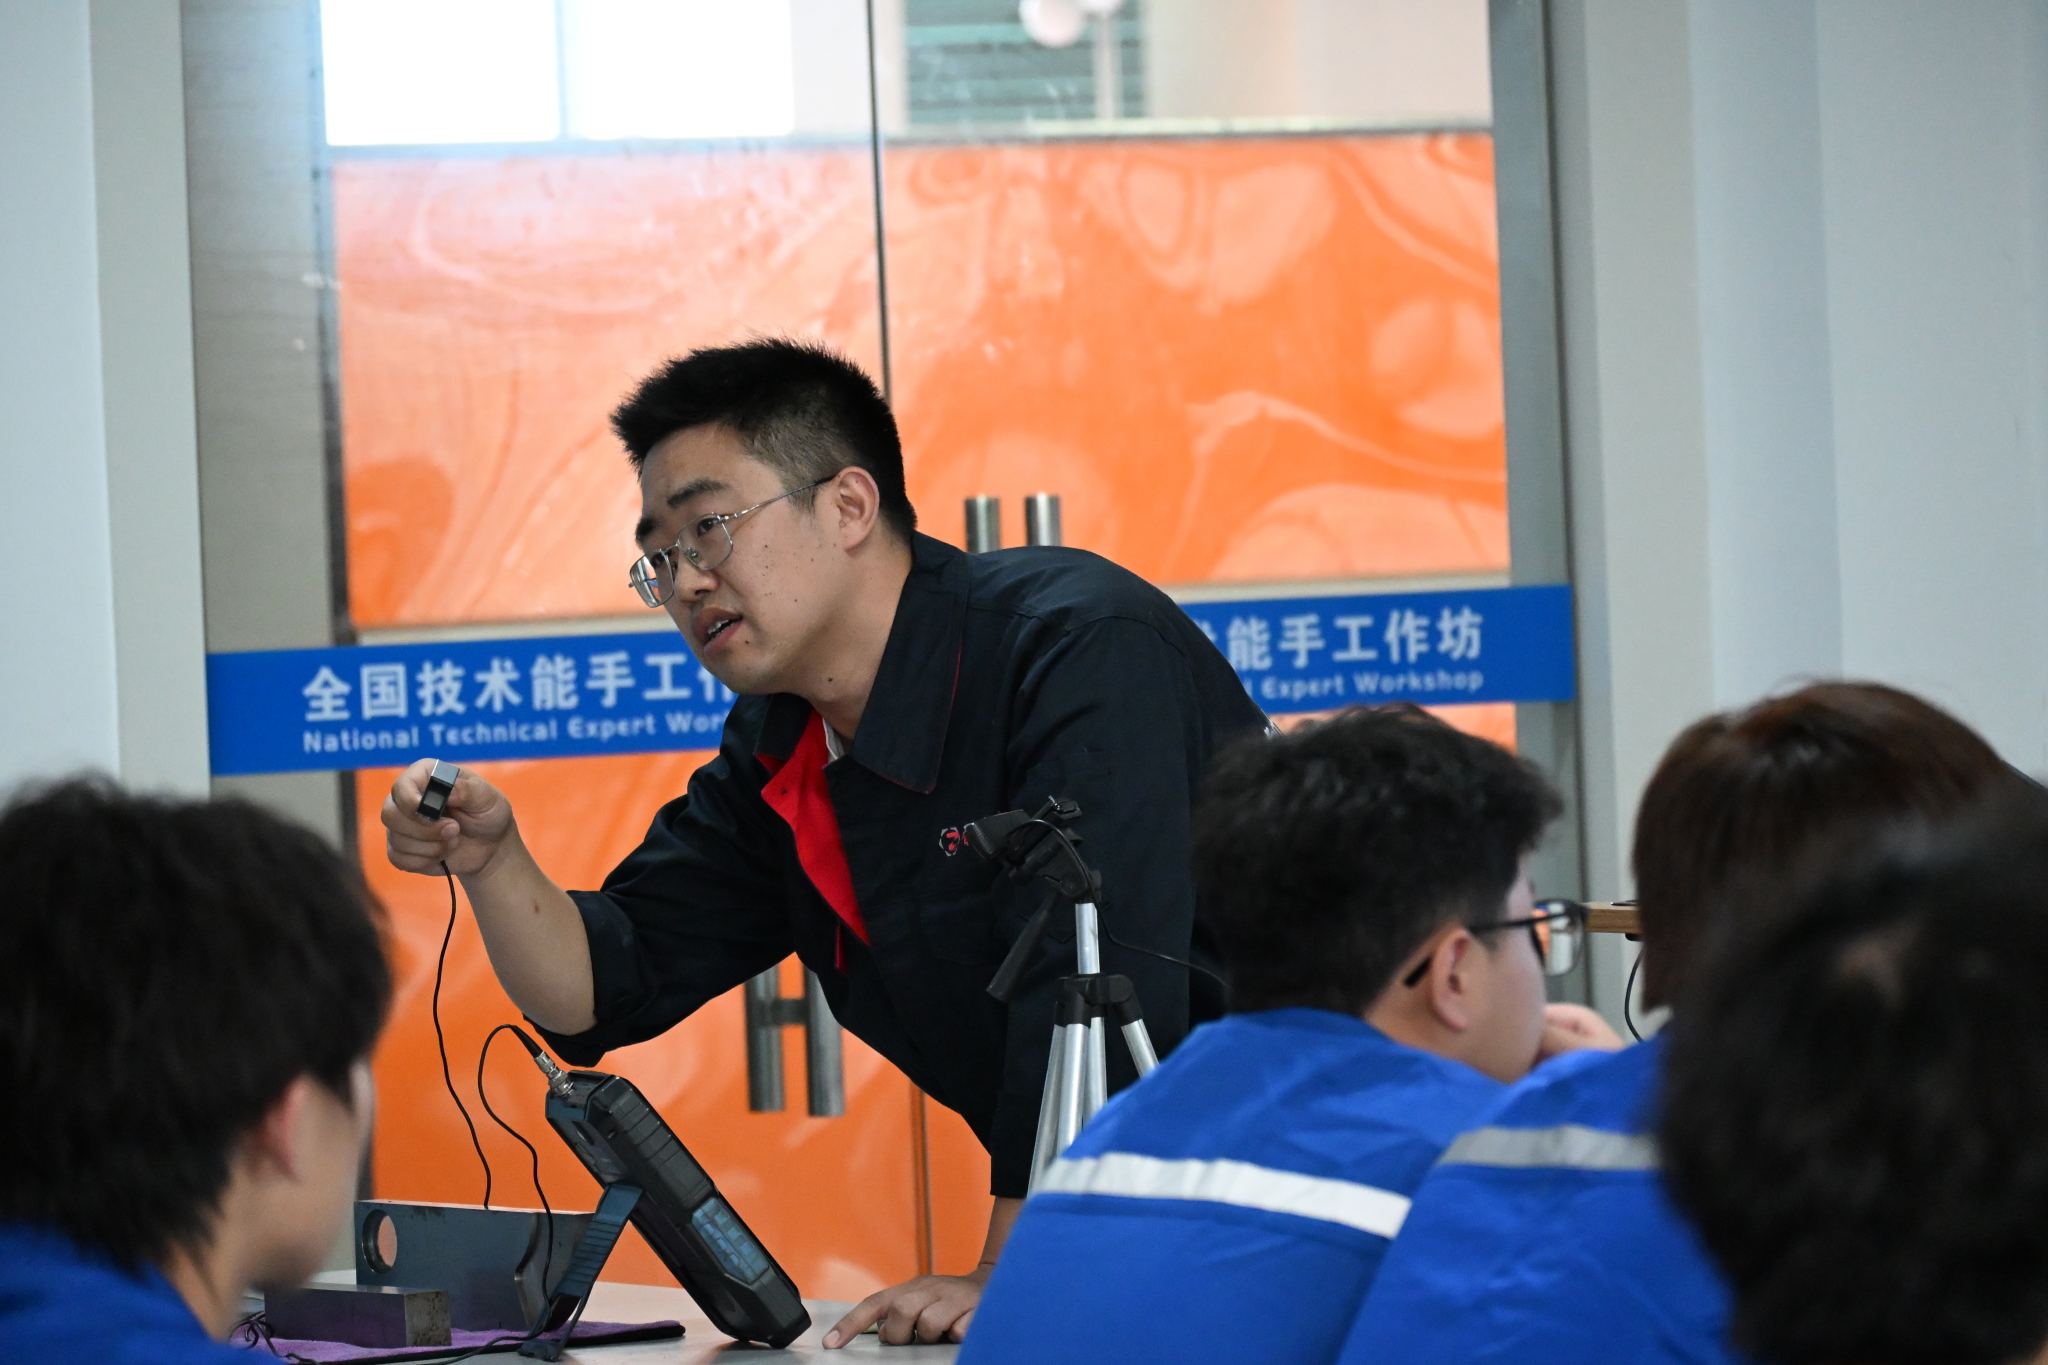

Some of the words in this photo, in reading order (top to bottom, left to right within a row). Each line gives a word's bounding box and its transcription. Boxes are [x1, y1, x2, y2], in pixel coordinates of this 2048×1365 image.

[1193, 605, 1484, 671] 能手工作坊
[1261, 674, 1345, 701] Expert
[1352, 669, 1484, 694] Workshop
[303, 725, 419, 753] National
[429, 718, 557, 747] Technical
[567, 713, 656, 742] Expert
[664, 710, 729, 734] Wor
